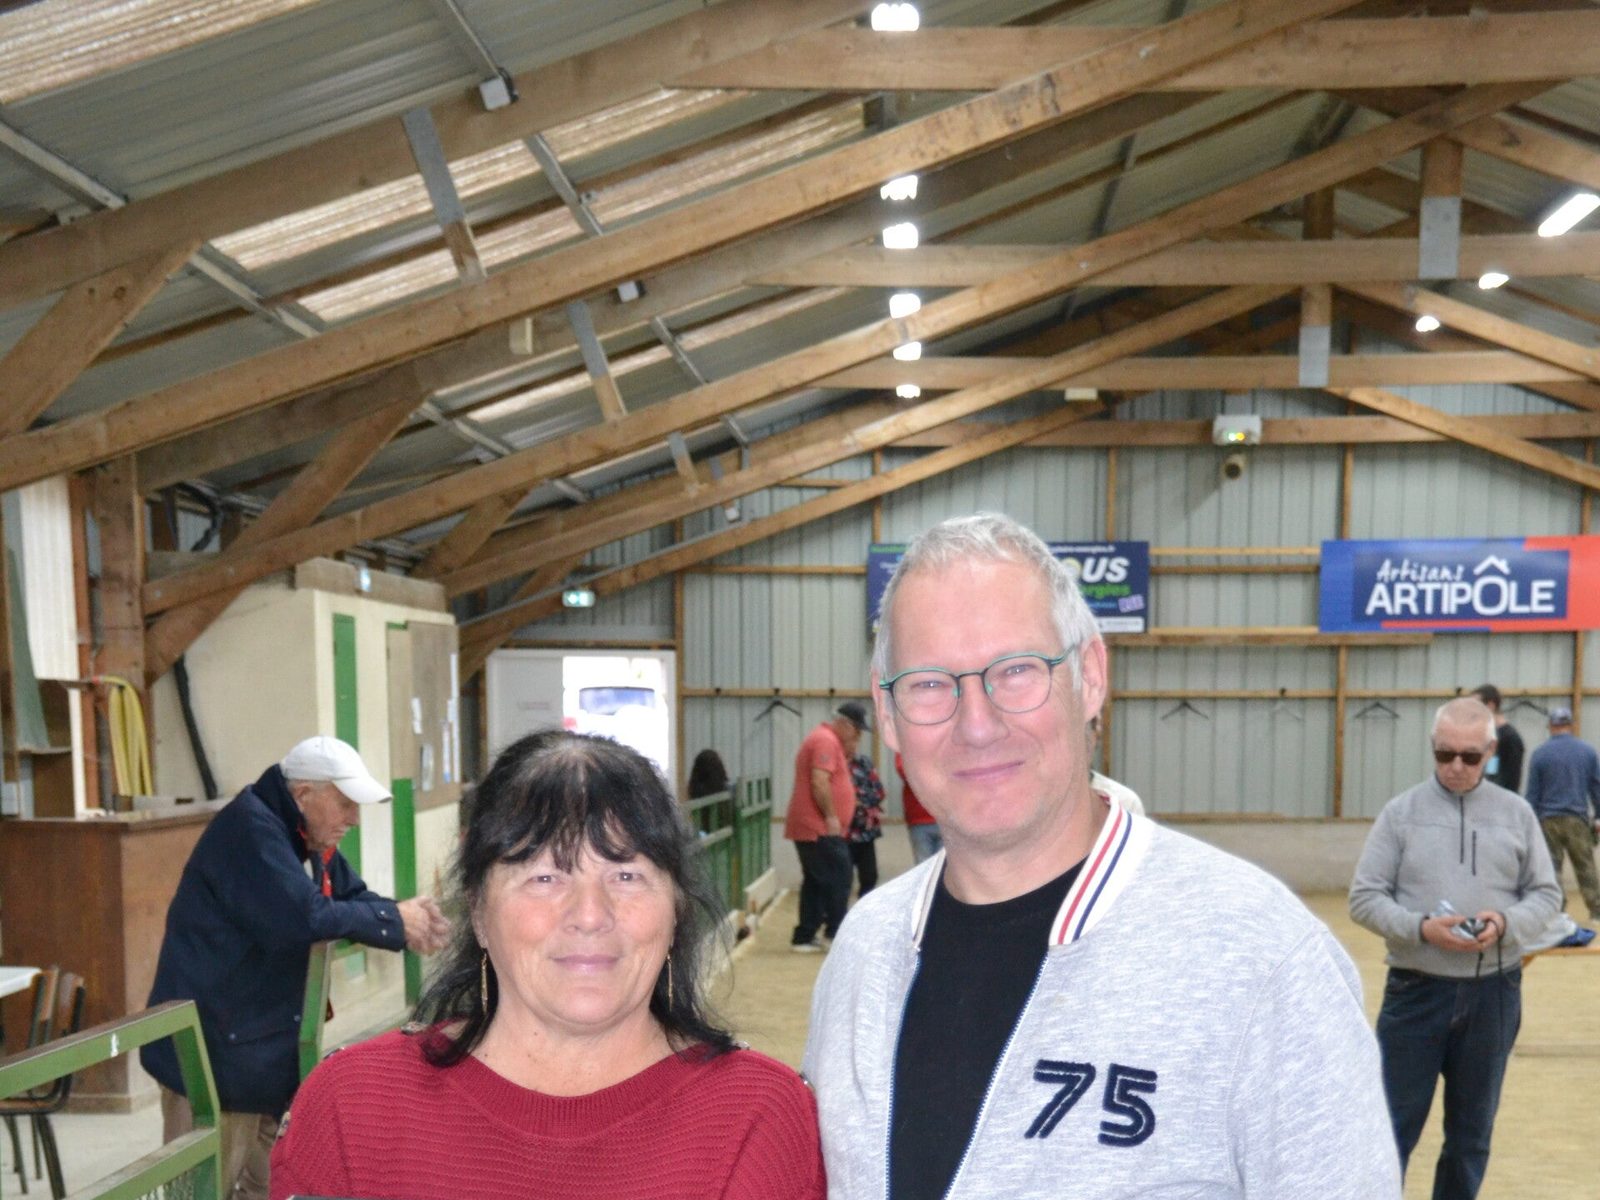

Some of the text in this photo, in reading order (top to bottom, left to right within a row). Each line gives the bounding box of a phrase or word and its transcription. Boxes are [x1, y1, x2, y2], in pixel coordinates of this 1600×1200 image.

[1365, 556, 1557, 617] ARTIPÔLE
[1376, 558, 1465, 582] Artisans
[1024, 1058, 1158, 1148] 75
